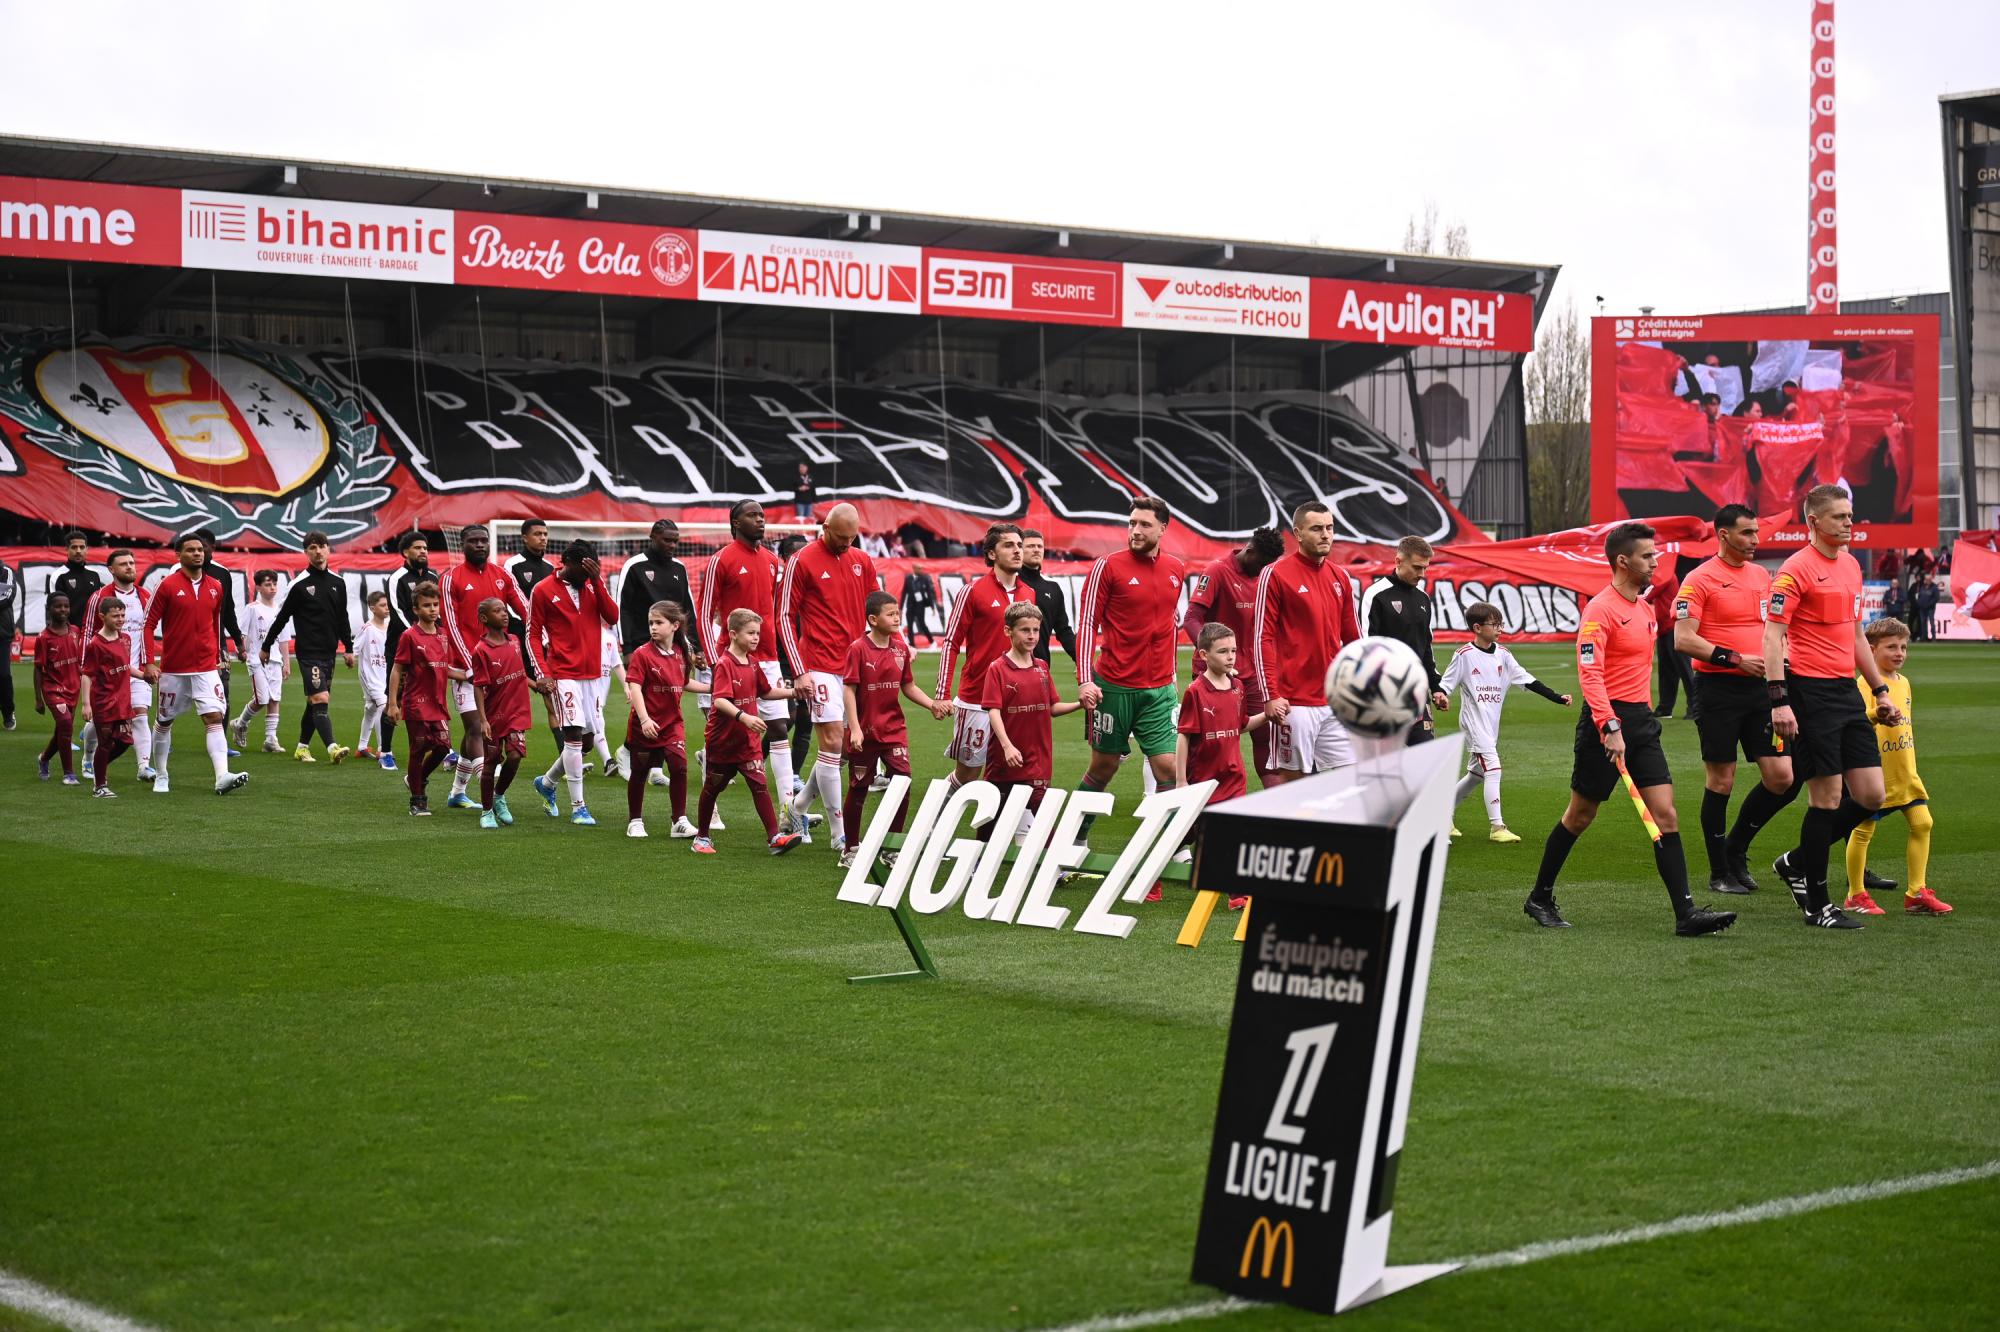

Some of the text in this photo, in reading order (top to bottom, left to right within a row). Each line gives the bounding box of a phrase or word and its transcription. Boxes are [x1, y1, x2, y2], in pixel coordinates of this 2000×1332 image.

[1978, 168, 2000, 182] GR
[1, 201, 136, 246] mme
[257, 207, 446, 255] bihannic
[257, 250, 314, 265] COUVERTURE
[379, 258, 418, 271] BARDAGE
[462, 225, 641, 279] Breizh Cola
[740, 254, 883, 300] ABARNOU
[1031, 282, 1095, 301] SECURITE
[1175, 280, 1302, 303] autodistribution
[1242, 310, 1302, 328] FICHOU
[1337, 289, 1445, 342] Aquila
[1668, 319, 1703, 328] Mutuel
[1638, 329, 1695, 340] de Bretagne
[1775, 532, 1806, 541] Stade
[1853, 532, 1867, 541] 29
[311, 666, 321, 680] 9
[564, 692, 574, 708] 2
[1093, 710, 1114, 734] 30
[964, 726, 985, 748] 13
[1281, 725, 1292, 747] 5
[837, 775, 1115, 930] LIGUE
[1236, 843, 1296, 882] LIGUE
[1259, 923, 1369, 975] Équipier
[1252, 967, 1365, 1004] du match
[1225, 1142, 1337, 1213] LIGUE 1
